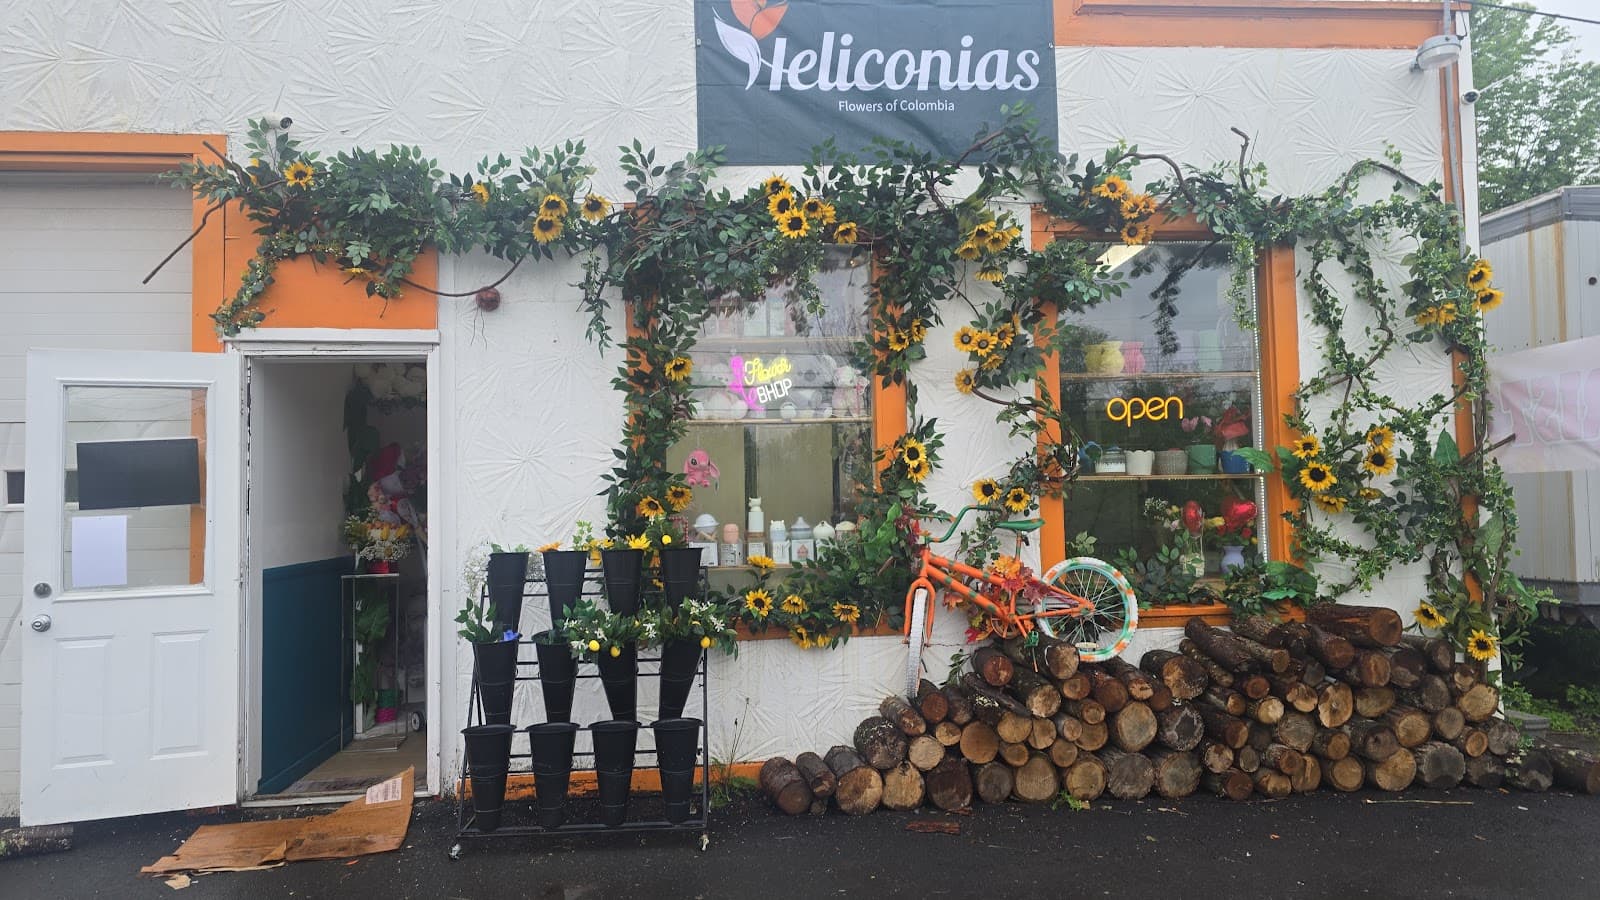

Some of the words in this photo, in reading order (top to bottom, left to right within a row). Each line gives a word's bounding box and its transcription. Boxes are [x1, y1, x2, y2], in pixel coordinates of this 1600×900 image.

[714, 16, 1040, 92] Heliconias
[838, 100, 883, 112] Flowers
[885, 98, 898, 112] of
[899, 98, 955, 112] Colombia
[1106, 396, 1184, 428] open
